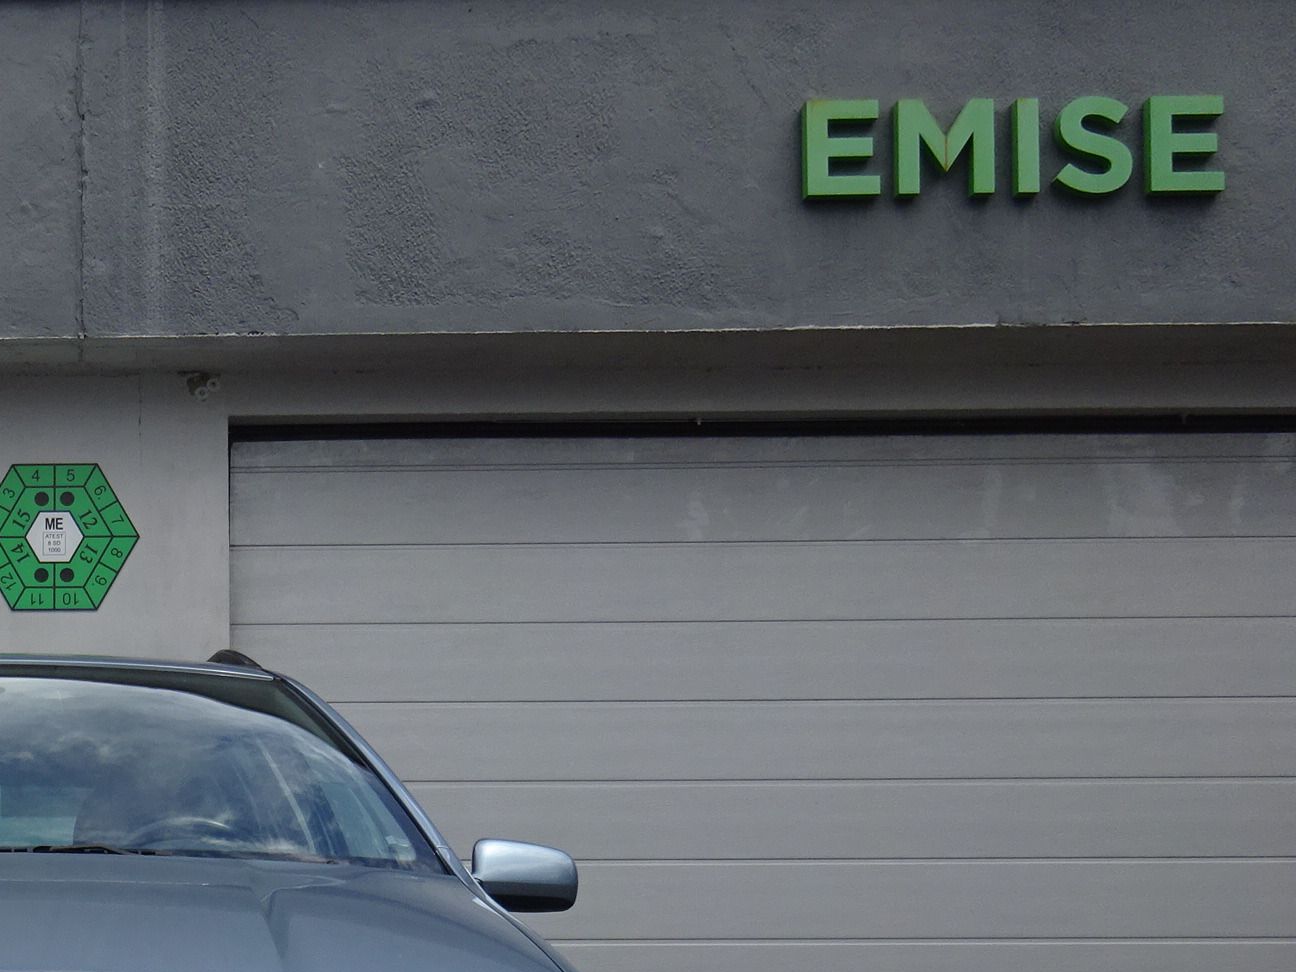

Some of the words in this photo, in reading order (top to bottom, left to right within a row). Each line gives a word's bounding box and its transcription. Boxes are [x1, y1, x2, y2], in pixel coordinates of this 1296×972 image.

[802, 94, 1226, 199] EMISE
[31, 469, 41, 481] 4
[66, 469, 76, 482] 5
[2, 487, 16, 499] 3
[11, 508, 32, 530] 15
[45, 517, 64, 530] ME
[77, 509, 98, 530] 12
[111, 514, 125, 525] 7
[11, 543, 31, 563] 14
[79, 543, 98, 564] 13
[110, 547, 124, 559] 8
[0, 572, 17, 591] 12
[30, 592, 44, 605] 11
[62, 592, 79, 605] 10
